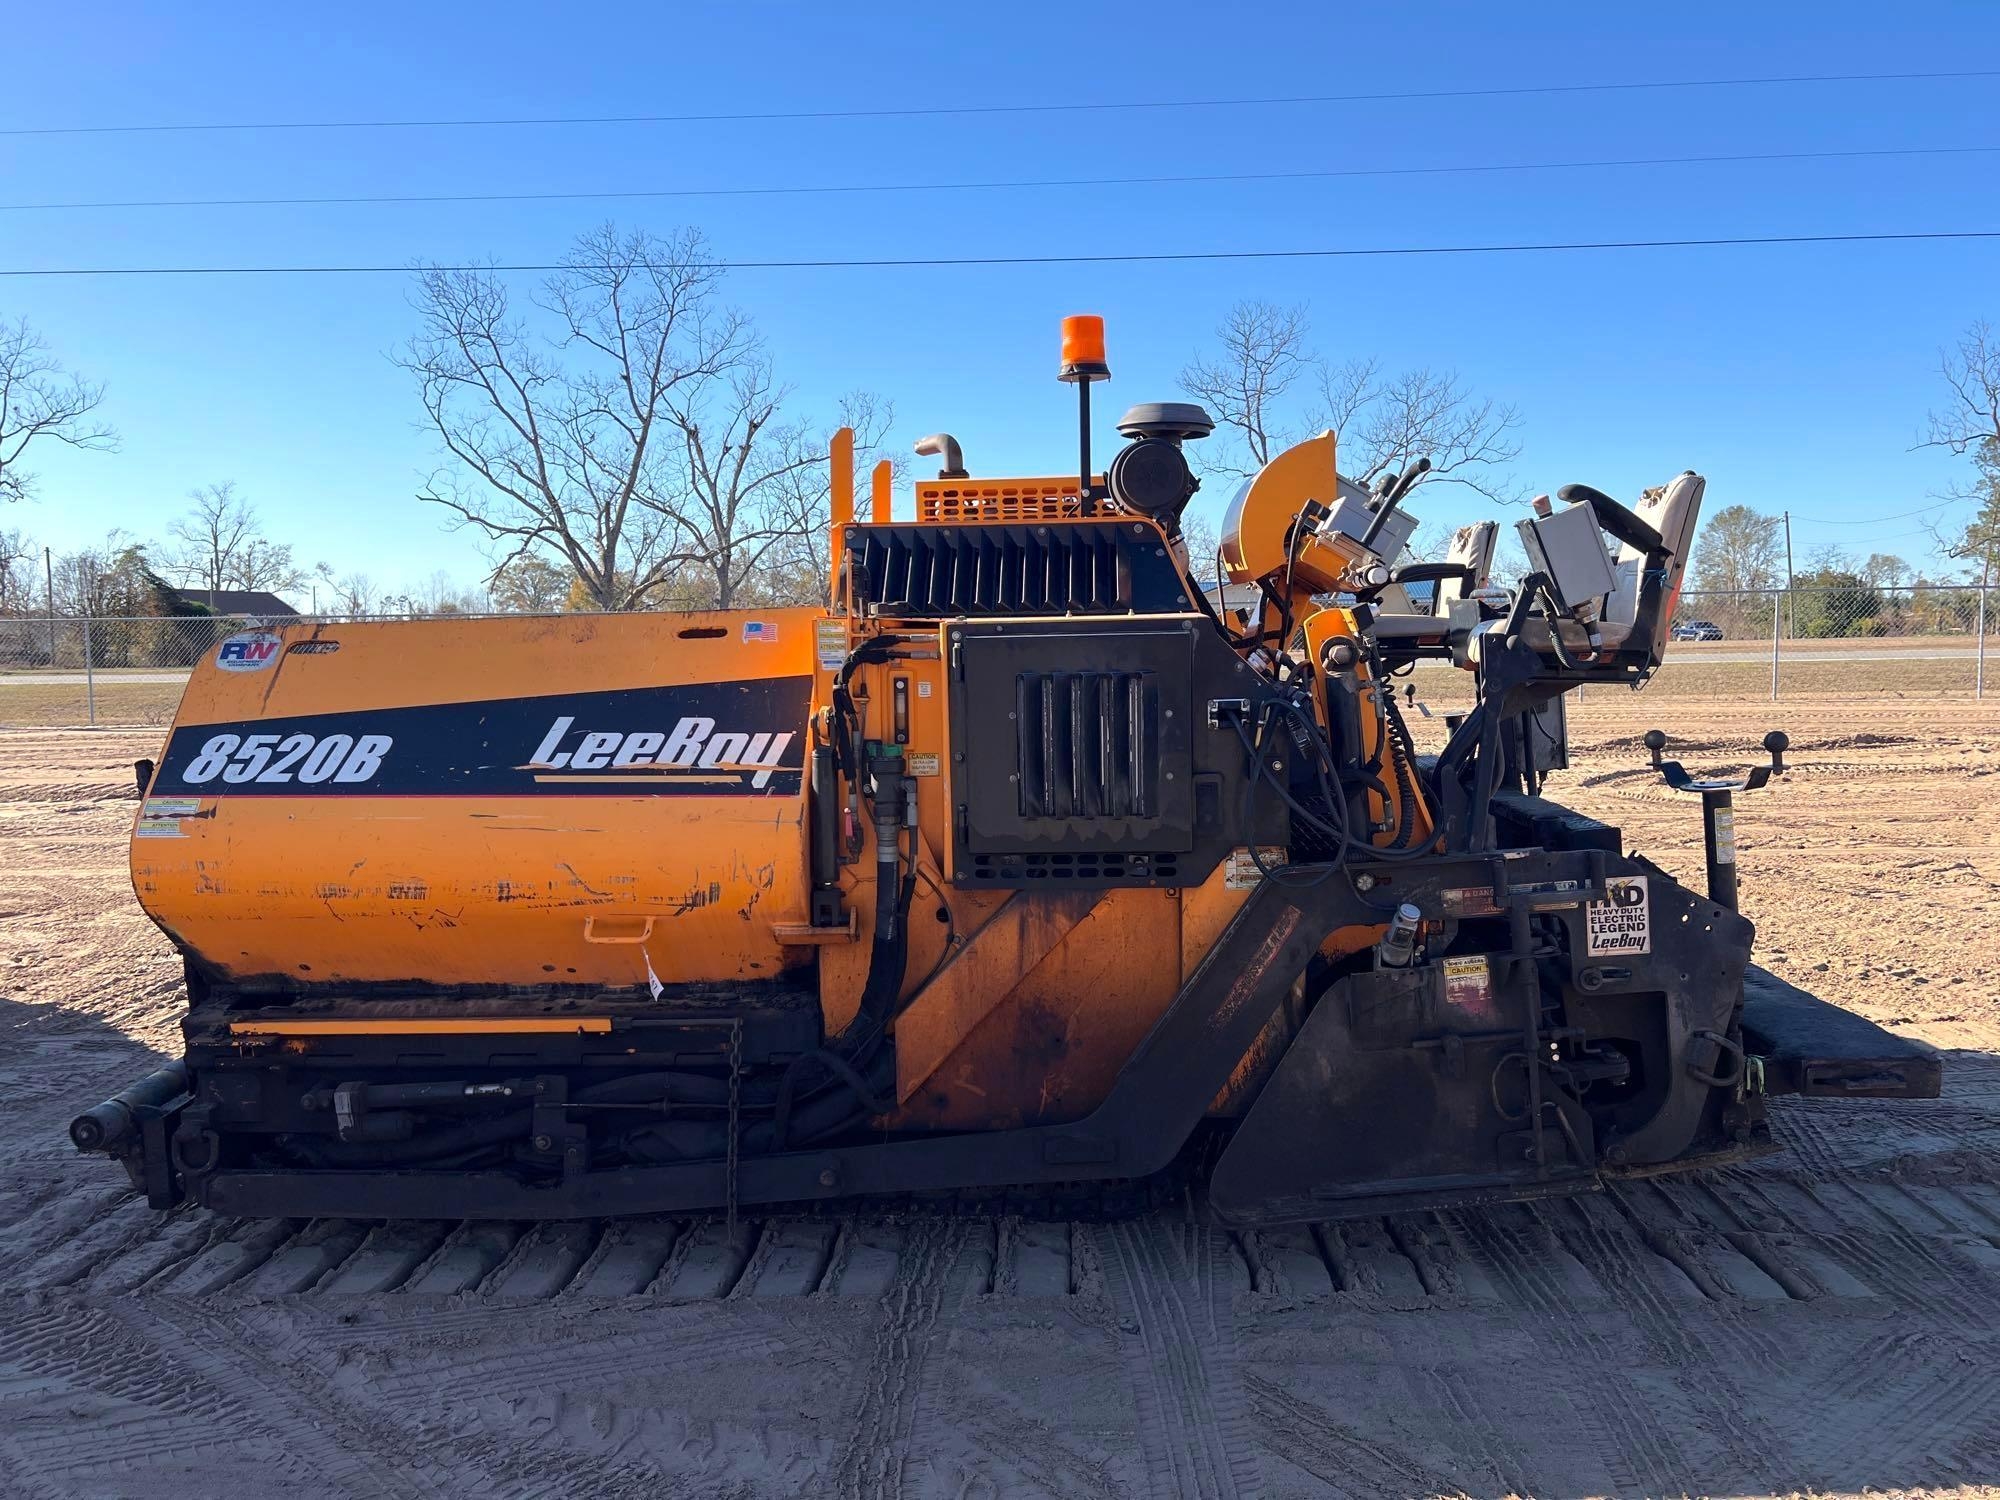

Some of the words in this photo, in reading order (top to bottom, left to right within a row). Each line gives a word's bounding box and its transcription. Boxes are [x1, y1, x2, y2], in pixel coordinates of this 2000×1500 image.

[219, 643, 278, 660] RW
[182, 733, 393, 784] 8520B
[529, 716, 794, 789] LeeBoy
[1620, 907, 1645, 915] DUTY
[1590, 914, 1645, 925] ELECTRIC
[1591, 922, 1646, 934] LEGEND
[1591, 933, 1647, 951] LeeBoy
[1451, 966, 1482, 974] CAUTION
